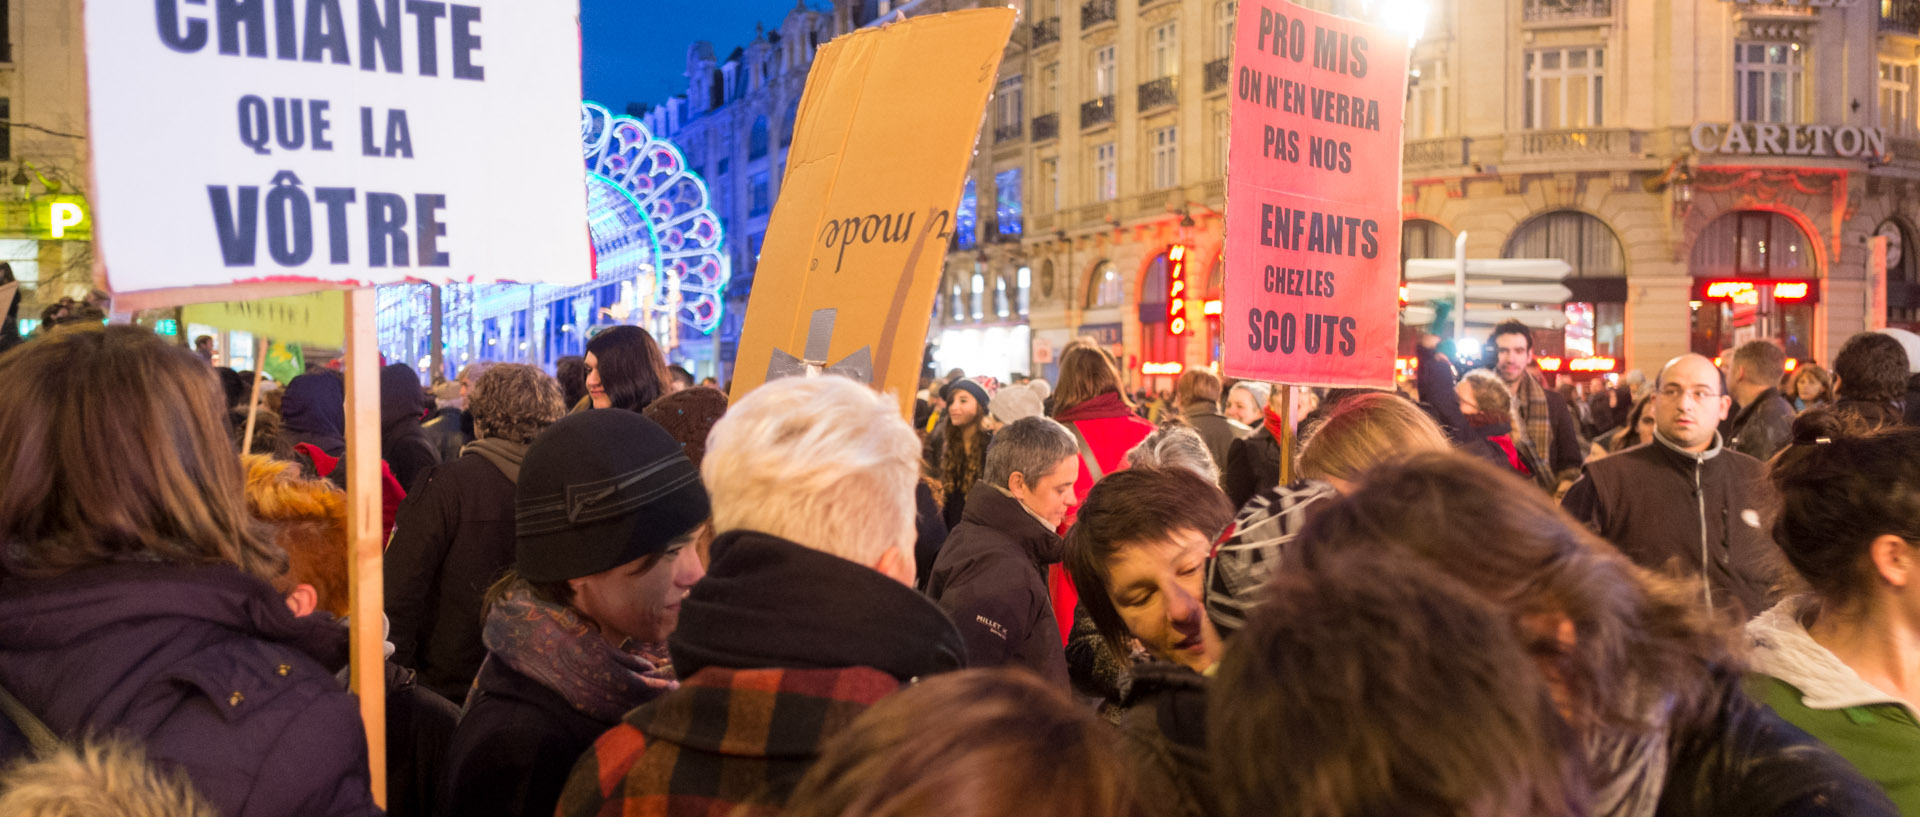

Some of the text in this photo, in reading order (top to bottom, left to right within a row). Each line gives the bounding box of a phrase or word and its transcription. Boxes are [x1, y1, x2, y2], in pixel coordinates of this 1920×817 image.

[154, 0, 485, 81] CHIANTE
[237, 94, 415, 159] QUE LA
[1238, 65, 1380, 132] ON N'EN VERRA
[1263, 124, 1352, 174] PAS NOS
[1691, 121, 1888, 157] CARLTON
[50, 202, 83, 238] P
[206, 169, 451, 268] VÔTRE
[818, 210, 917, 274] mode
[1260, 202, 1379, 260] ENFANTS
[976, 614, 1002, 631] MILLET
